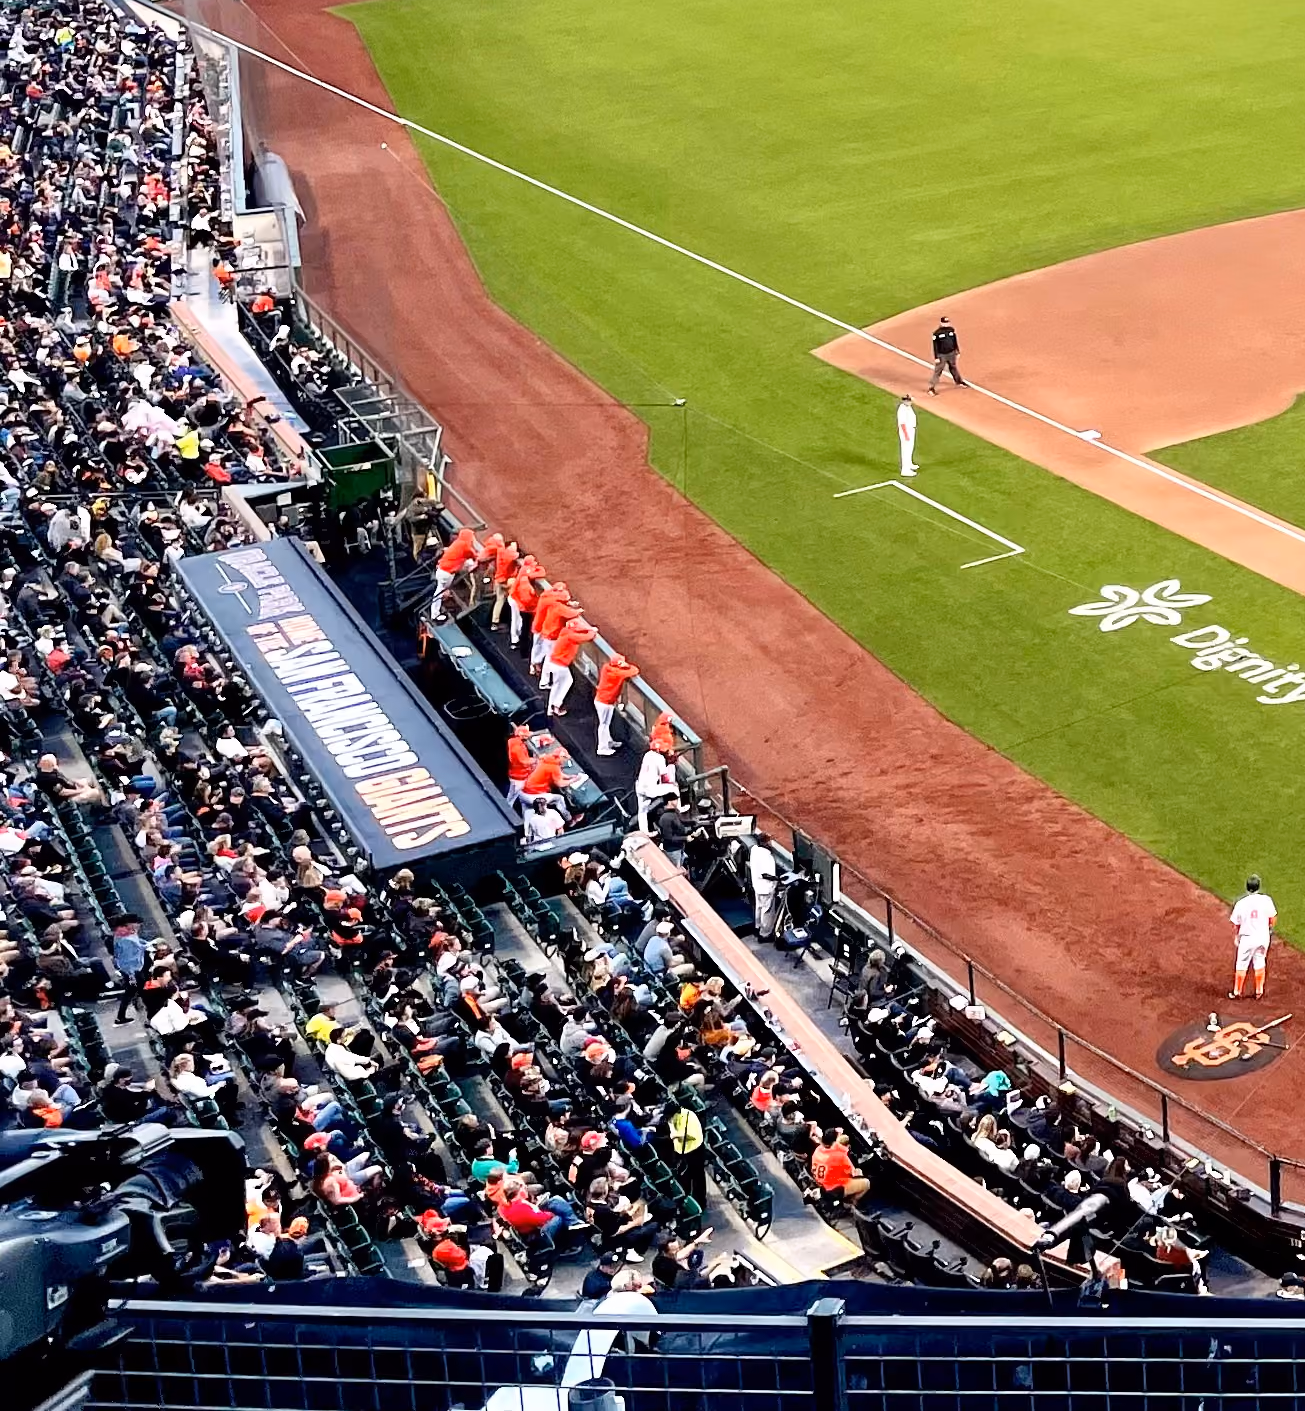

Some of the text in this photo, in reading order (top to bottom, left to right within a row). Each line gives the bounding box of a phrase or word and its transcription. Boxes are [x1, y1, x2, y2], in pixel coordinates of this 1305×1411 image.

[264, 639, 472, 850] SAN FRANCISCO GIANTS
